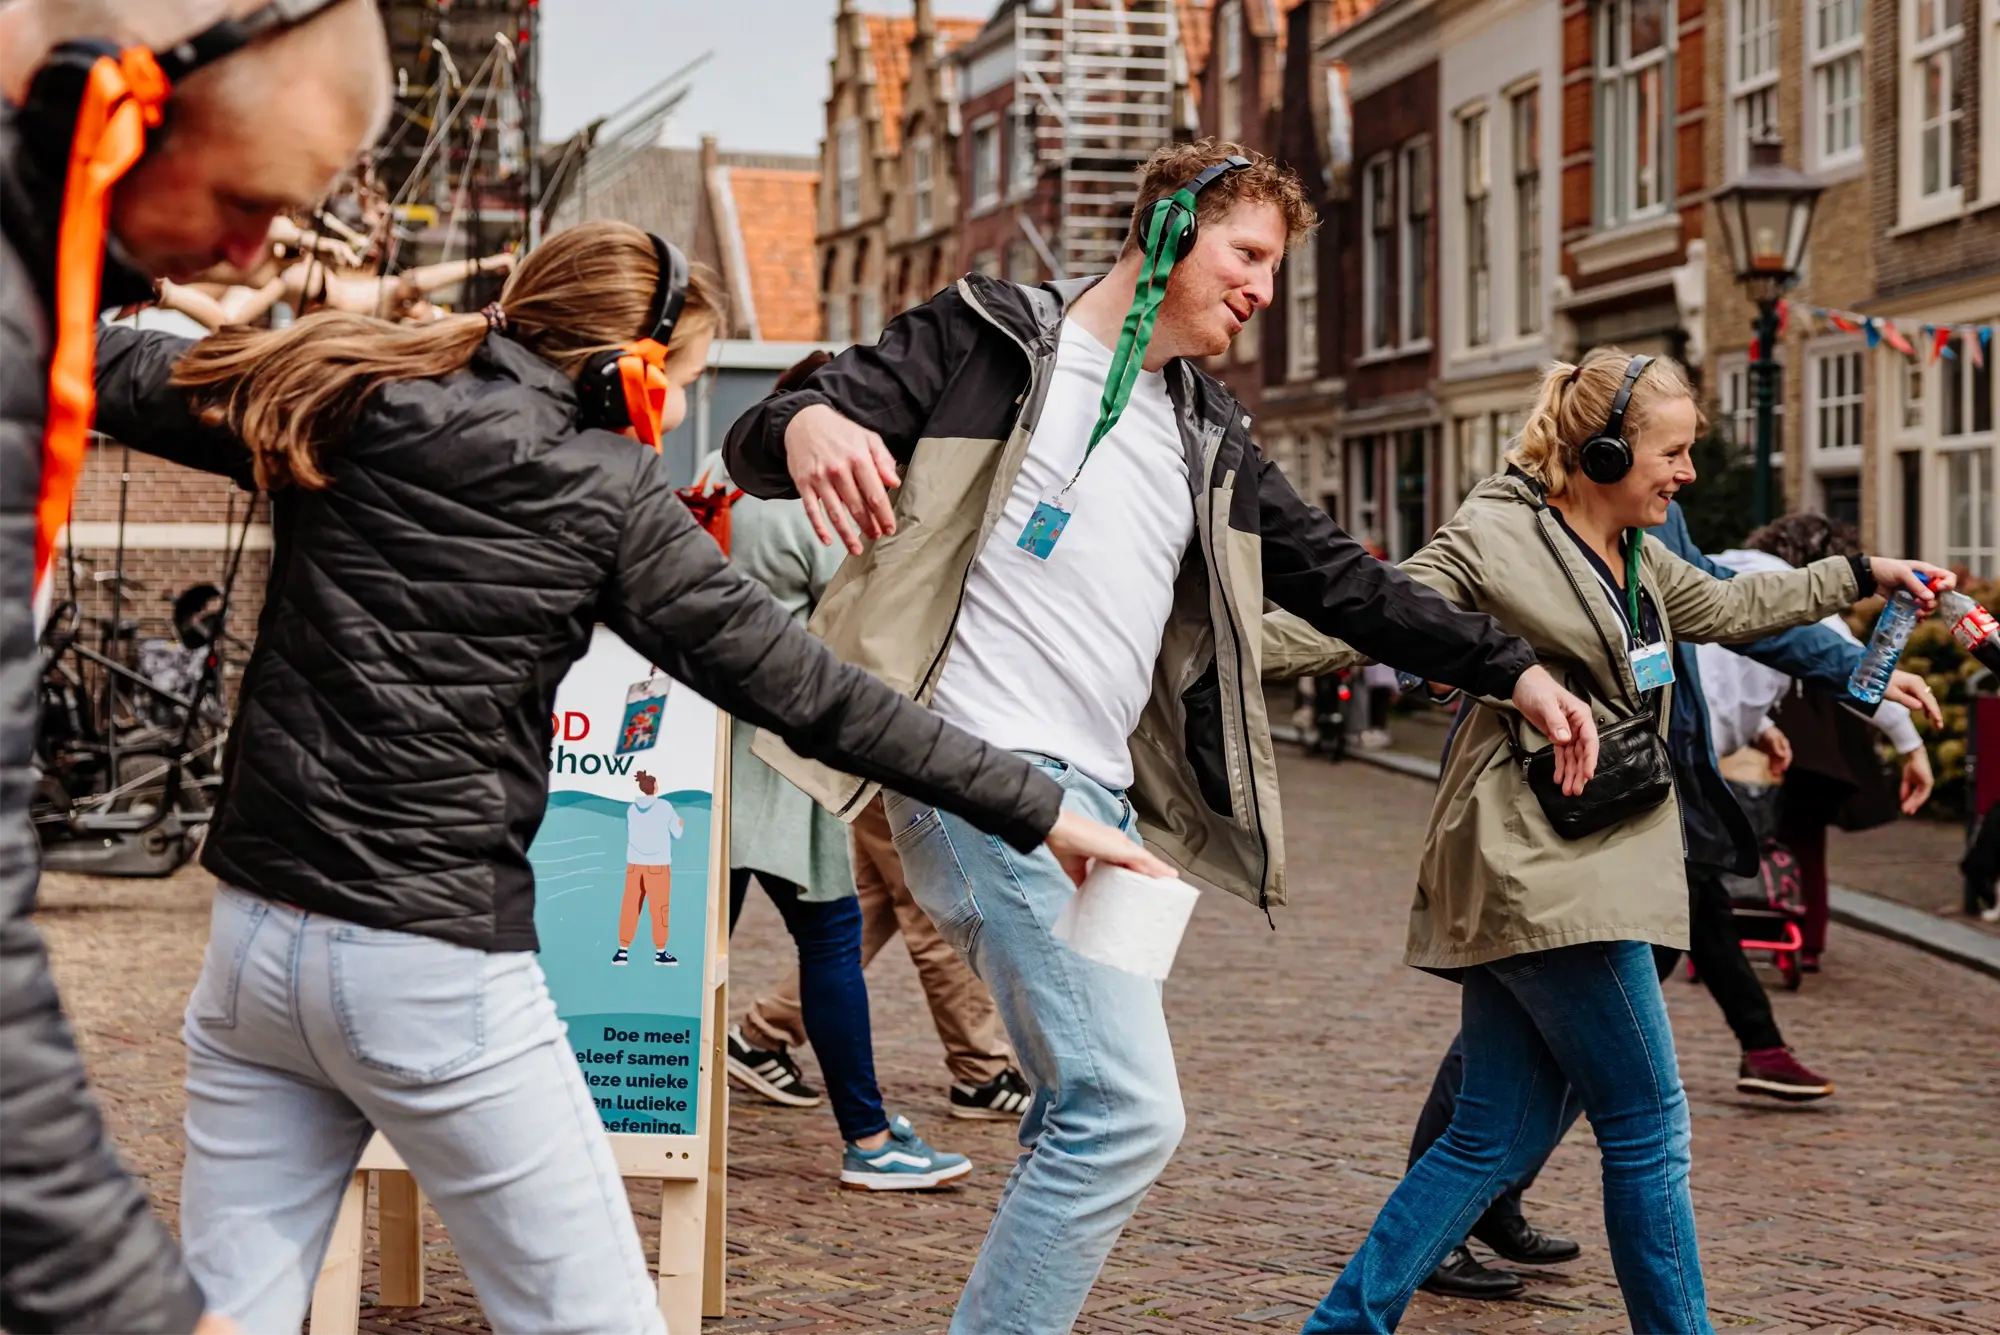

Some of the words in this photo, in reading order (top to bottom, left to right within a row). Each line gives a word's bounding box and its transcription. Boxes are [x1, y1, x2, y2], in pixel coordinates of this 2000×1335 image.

[603, 1027, 639, 1042] Doe
[644, 1029, 690, 1044] mee!
[576, 1049, 624, 1064] eleef
[628, 1052, 689, 1067] samen
[626, 1073, 688, 1089] unieke
[617, 1095, 687, 1112] ludieke
